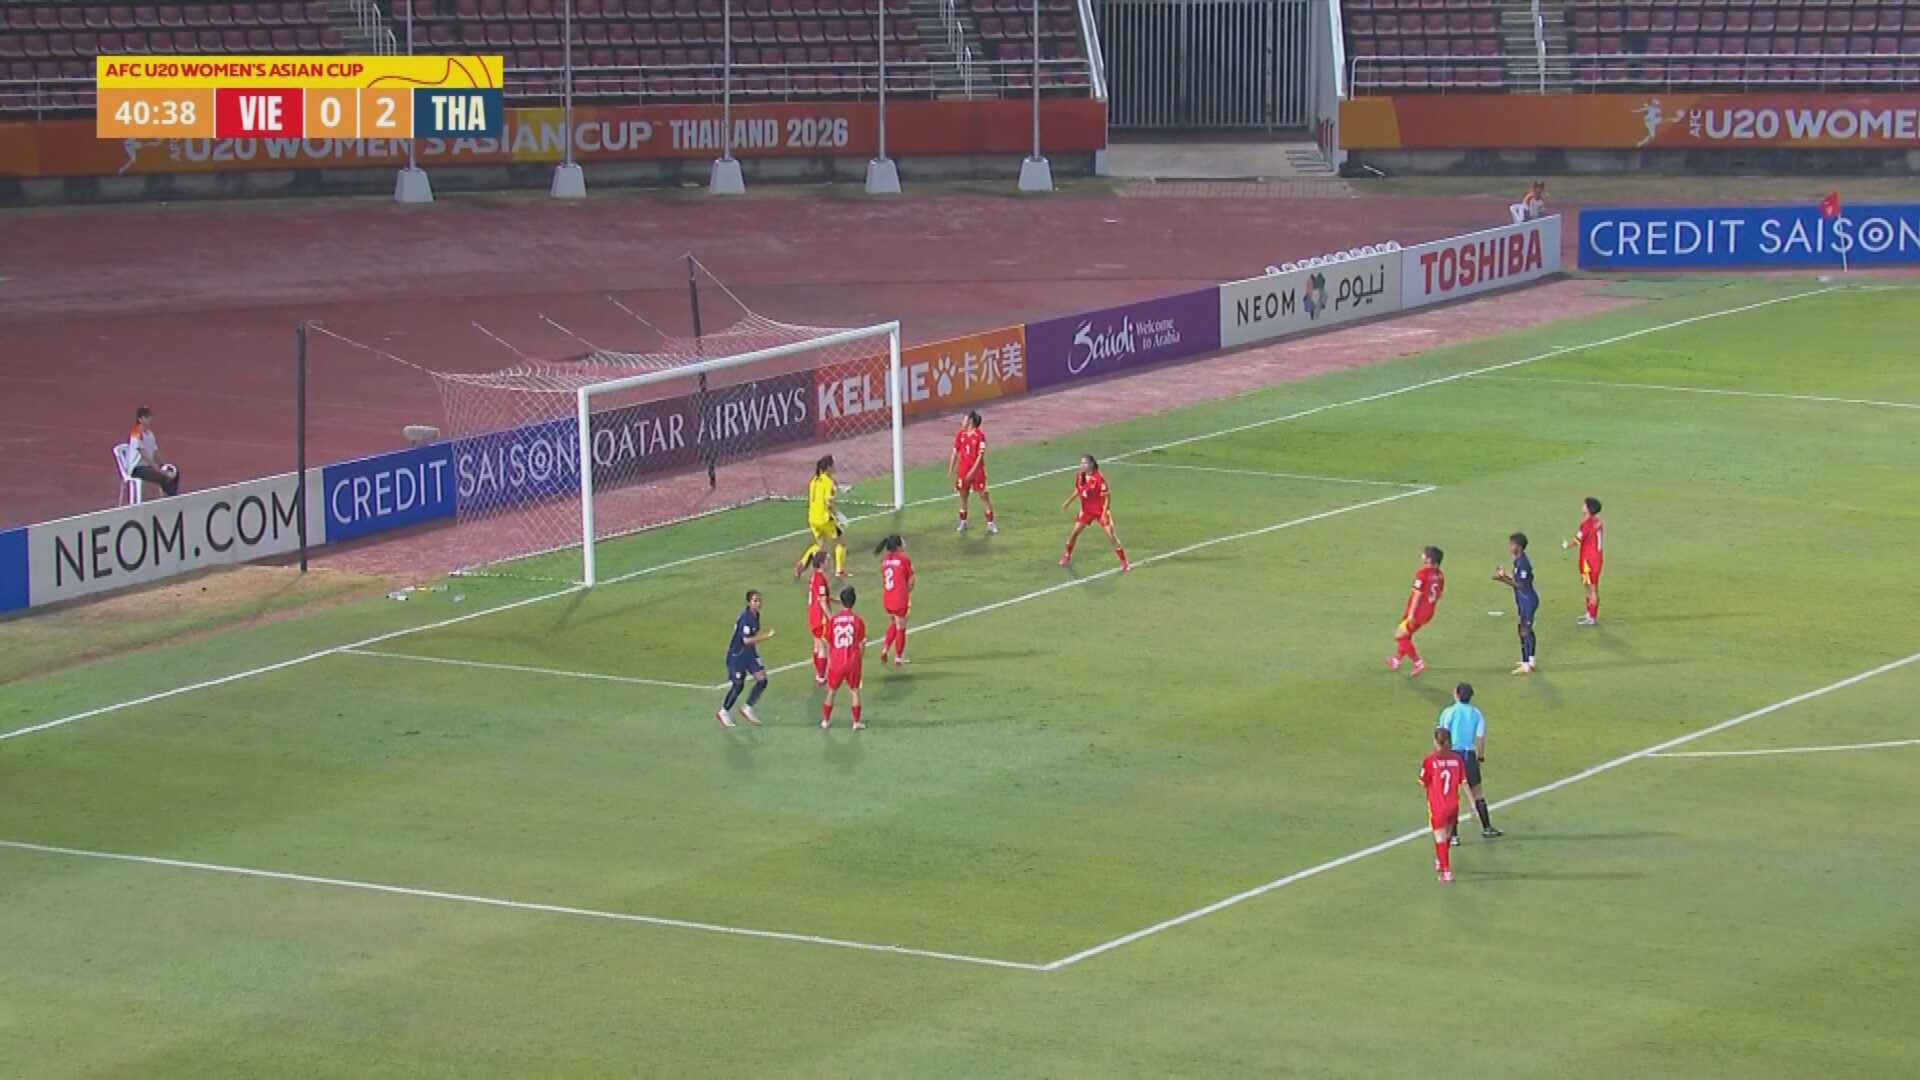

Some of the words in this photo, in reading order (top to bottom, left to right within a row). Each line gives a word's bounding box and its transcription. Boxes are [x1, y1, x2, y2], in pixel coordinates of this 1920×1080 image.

[575, 120, 652, 151] CUP
[669, 118, 779, 149] THAILAND
[787, 117, 849, 147] 2026
[1690, 109, 1702, 137] AFC
[1705, 109, 1779, 139] U20
[1784, 109, 1920, 139] WOME
[1590, 219, 1745, 257] CREDIT
[1759, 217, 1920, 253] SAISON
[1420, 229, 1543, 295] TOSHIBA
[1236, 288, 1296, 326] NEOM
[1335, 264, 1385, 311] نيوم
[1136, 318, 1174, 335] Welcome
[1142, 336, 1152, 350] to
[1153, 329, 1181, 348] Arabia
[959, 341, 1024, 390] 卡尔美
[818, 361, 930, 421] KELME
[593, 413, 685, 466] QATAR
[697, 387, 807, 444] AIRWAYS
[332, 459, 448, 525] CREDIT
[459, 436, 576, 497] SAISON
[54, 485, 300, 587] NEOM.COM
[1440, 770, 1451, 795] 7
